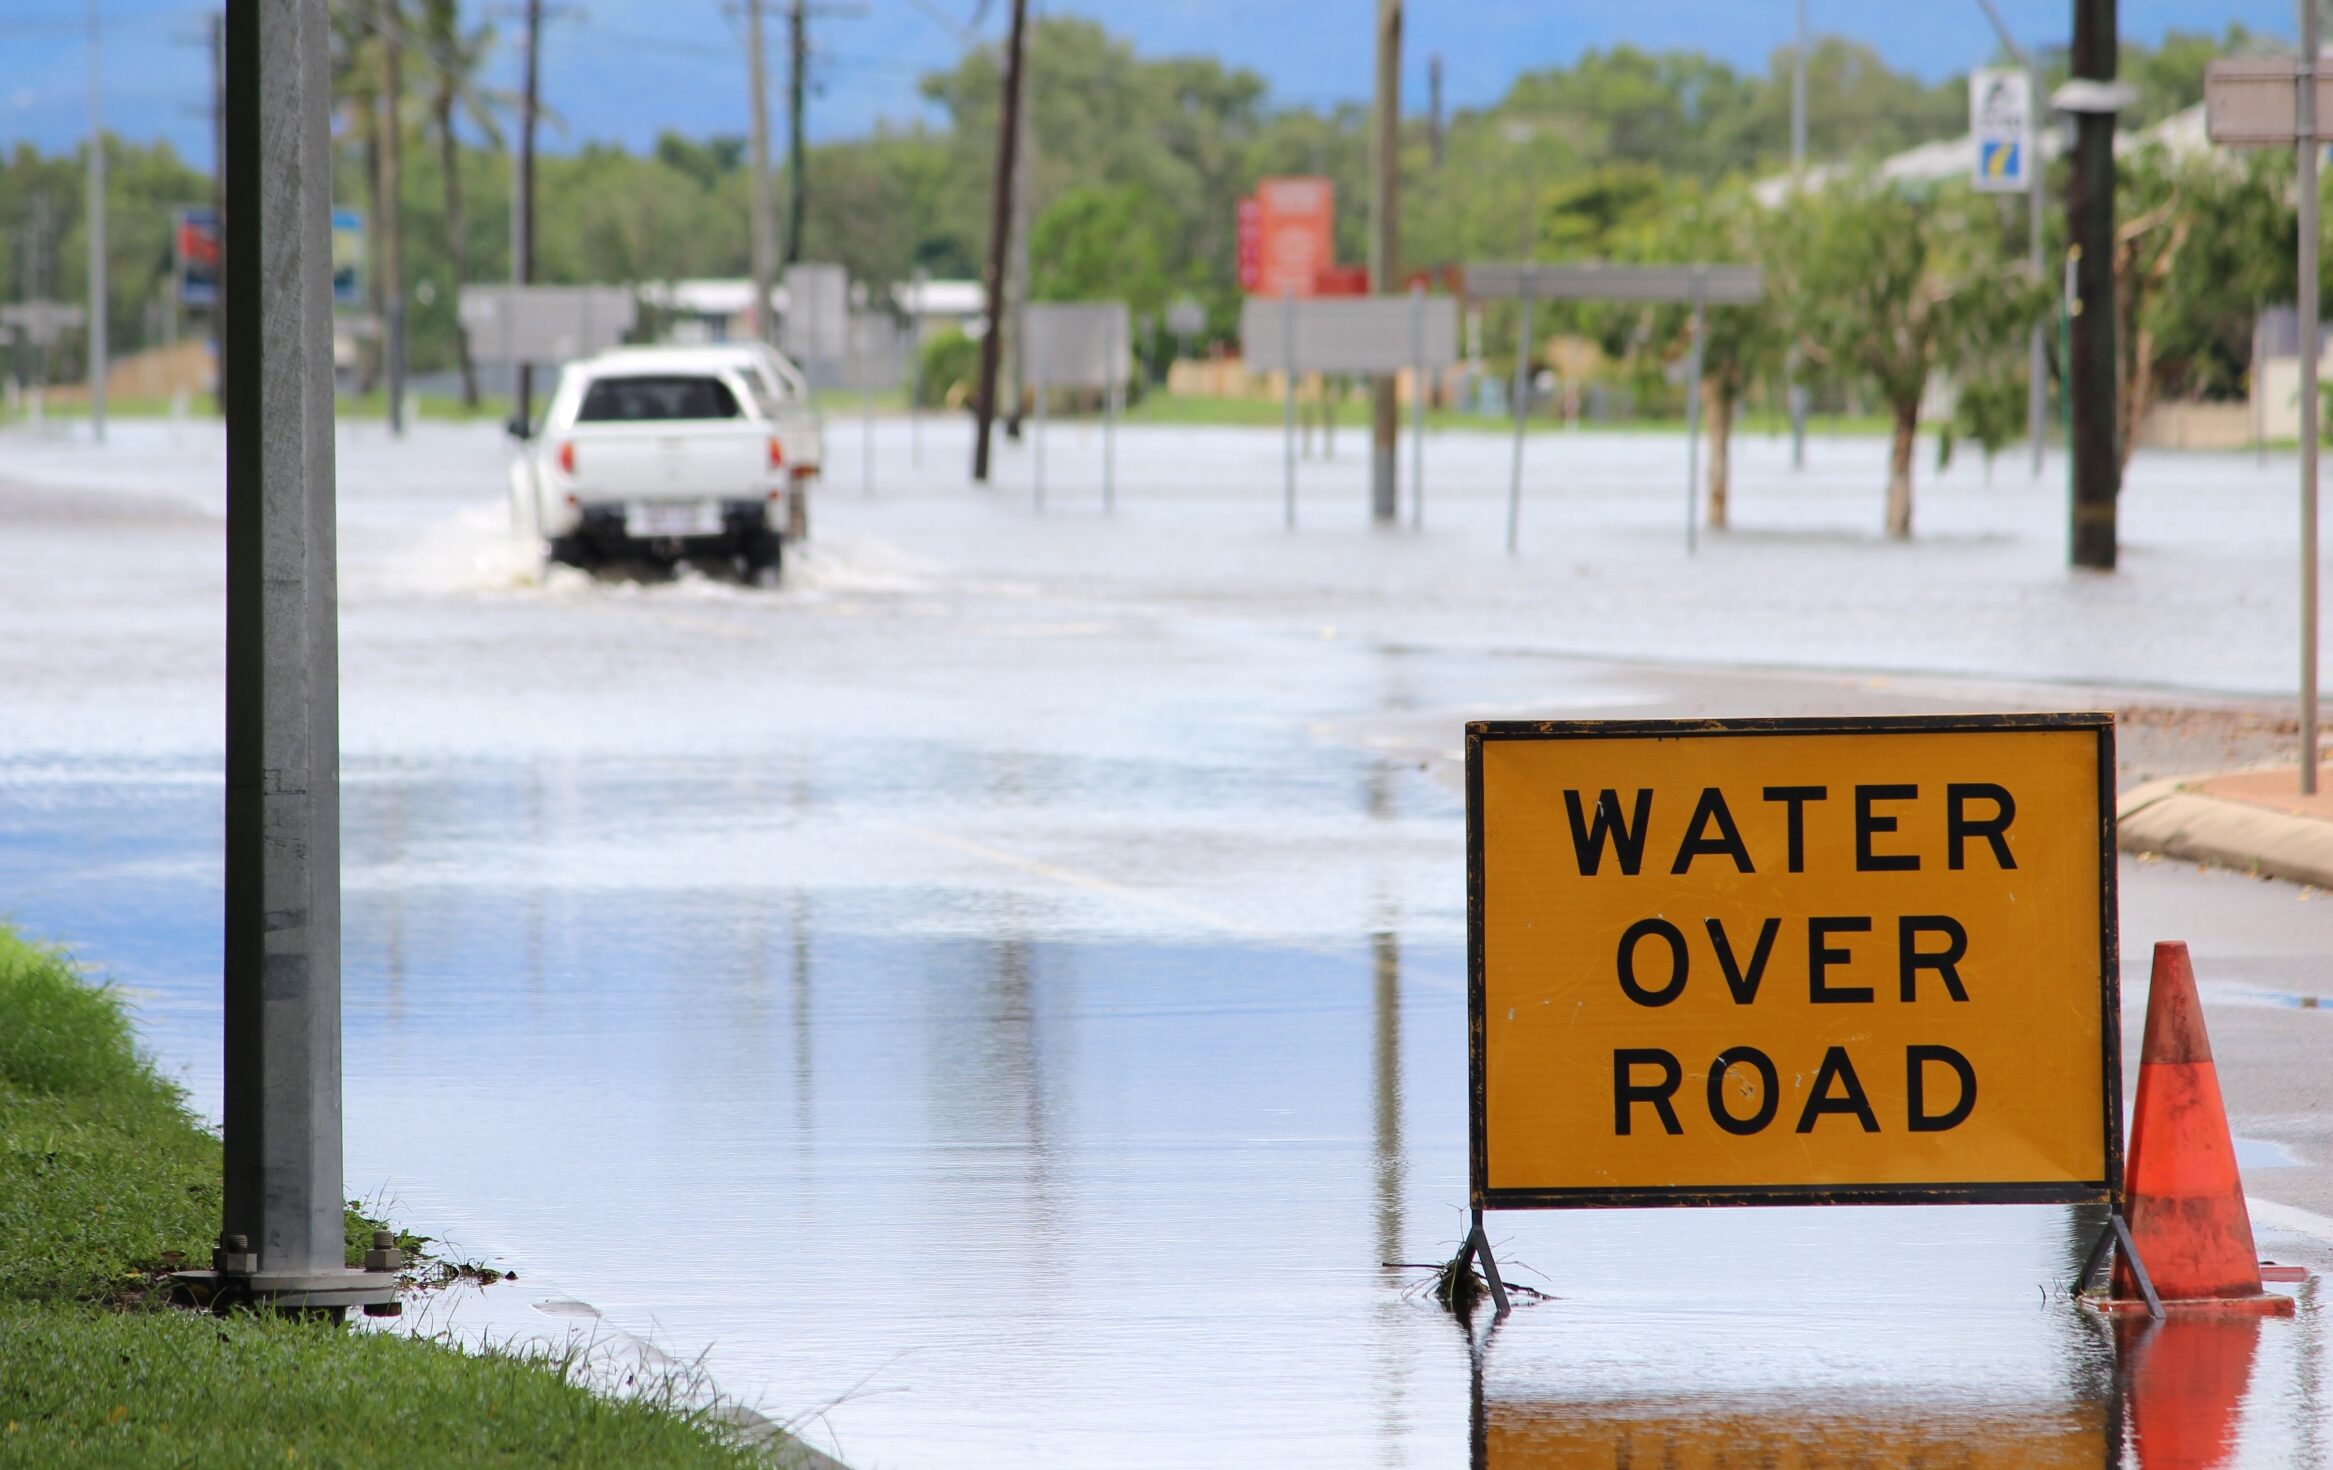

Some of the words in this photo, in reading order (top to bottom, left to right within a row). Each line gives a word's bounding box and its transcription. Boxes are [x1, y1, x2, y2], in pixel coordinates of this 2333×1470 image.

[1563, 783, 2018, 877] WATER
[1617, 915, 1970, 1008] OVER
[1613, 1045, 1978, 1136] ROAD
